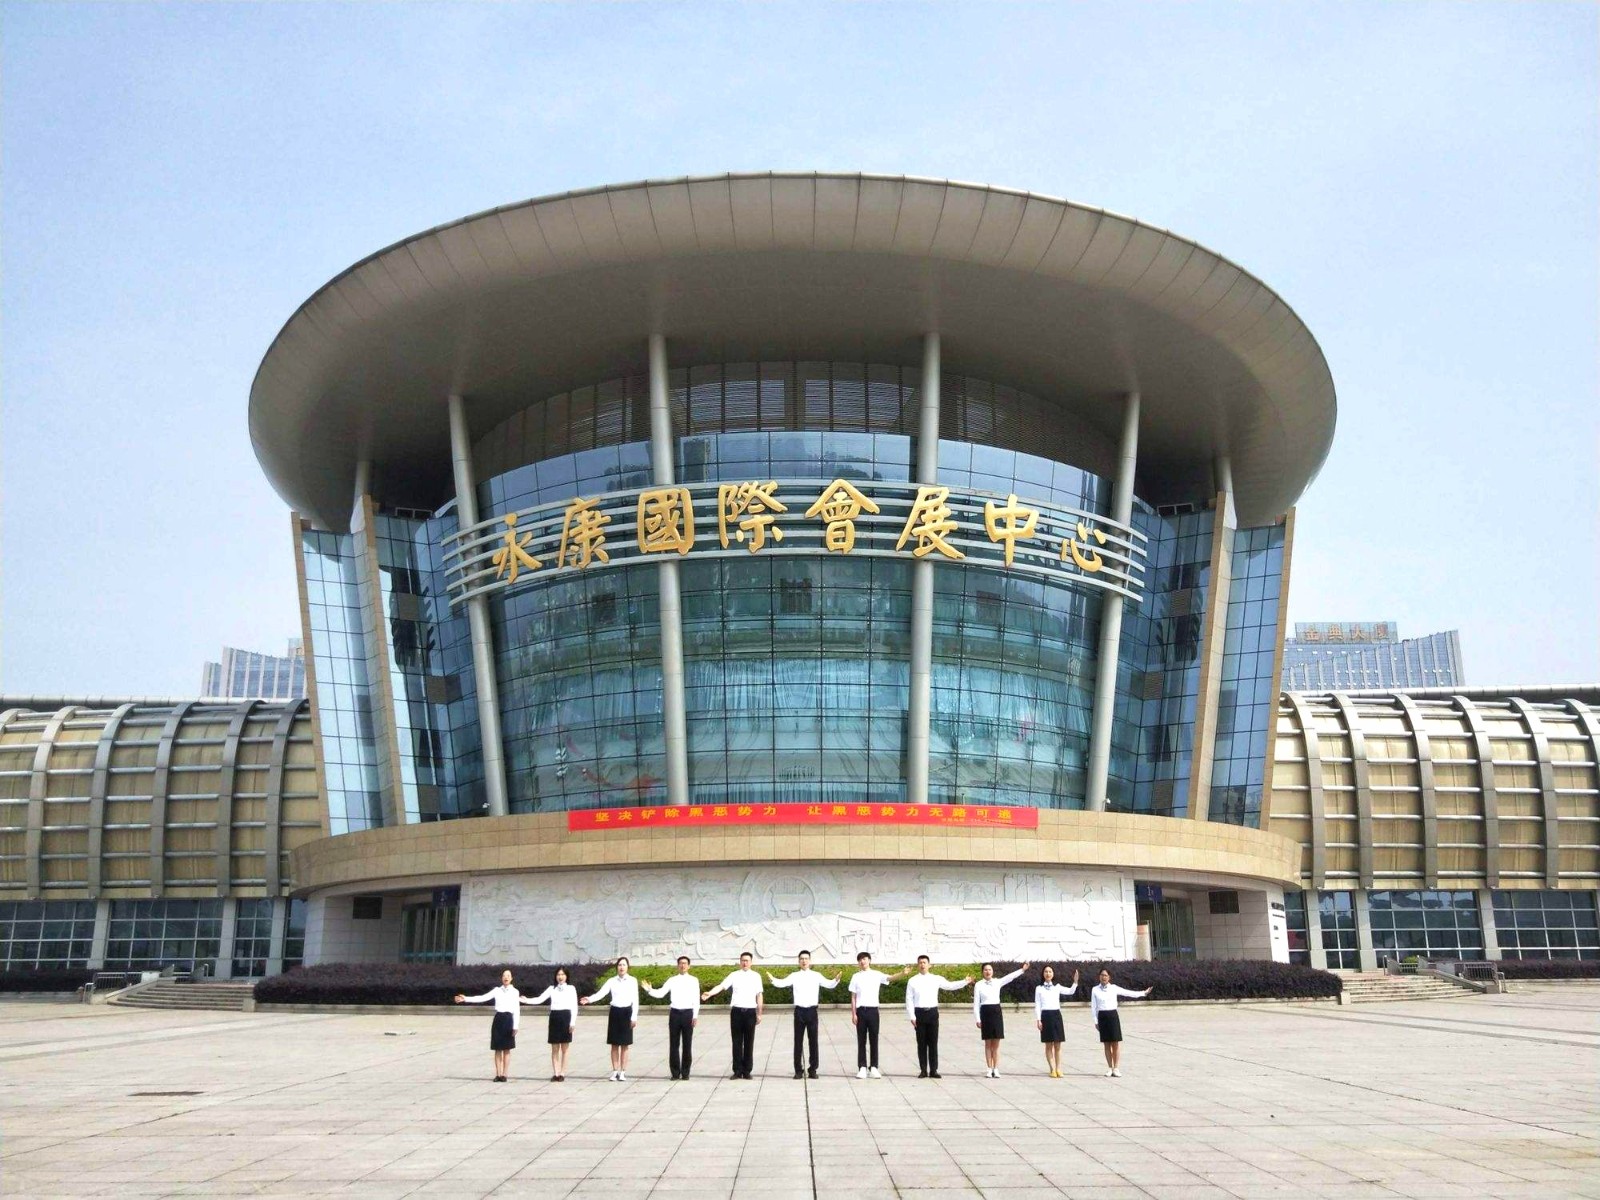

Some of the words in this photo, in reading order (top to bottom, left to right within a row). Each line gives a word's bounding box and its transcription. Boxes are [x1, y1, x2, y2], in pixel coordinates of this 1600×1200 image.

[492, 478, 1106, 584] 永康國際會展中心
[594, 805, 777, 822] 坚决铲除黑恶势力
[807, 805, 1013, 820] 让黑恶势力无路可逃
